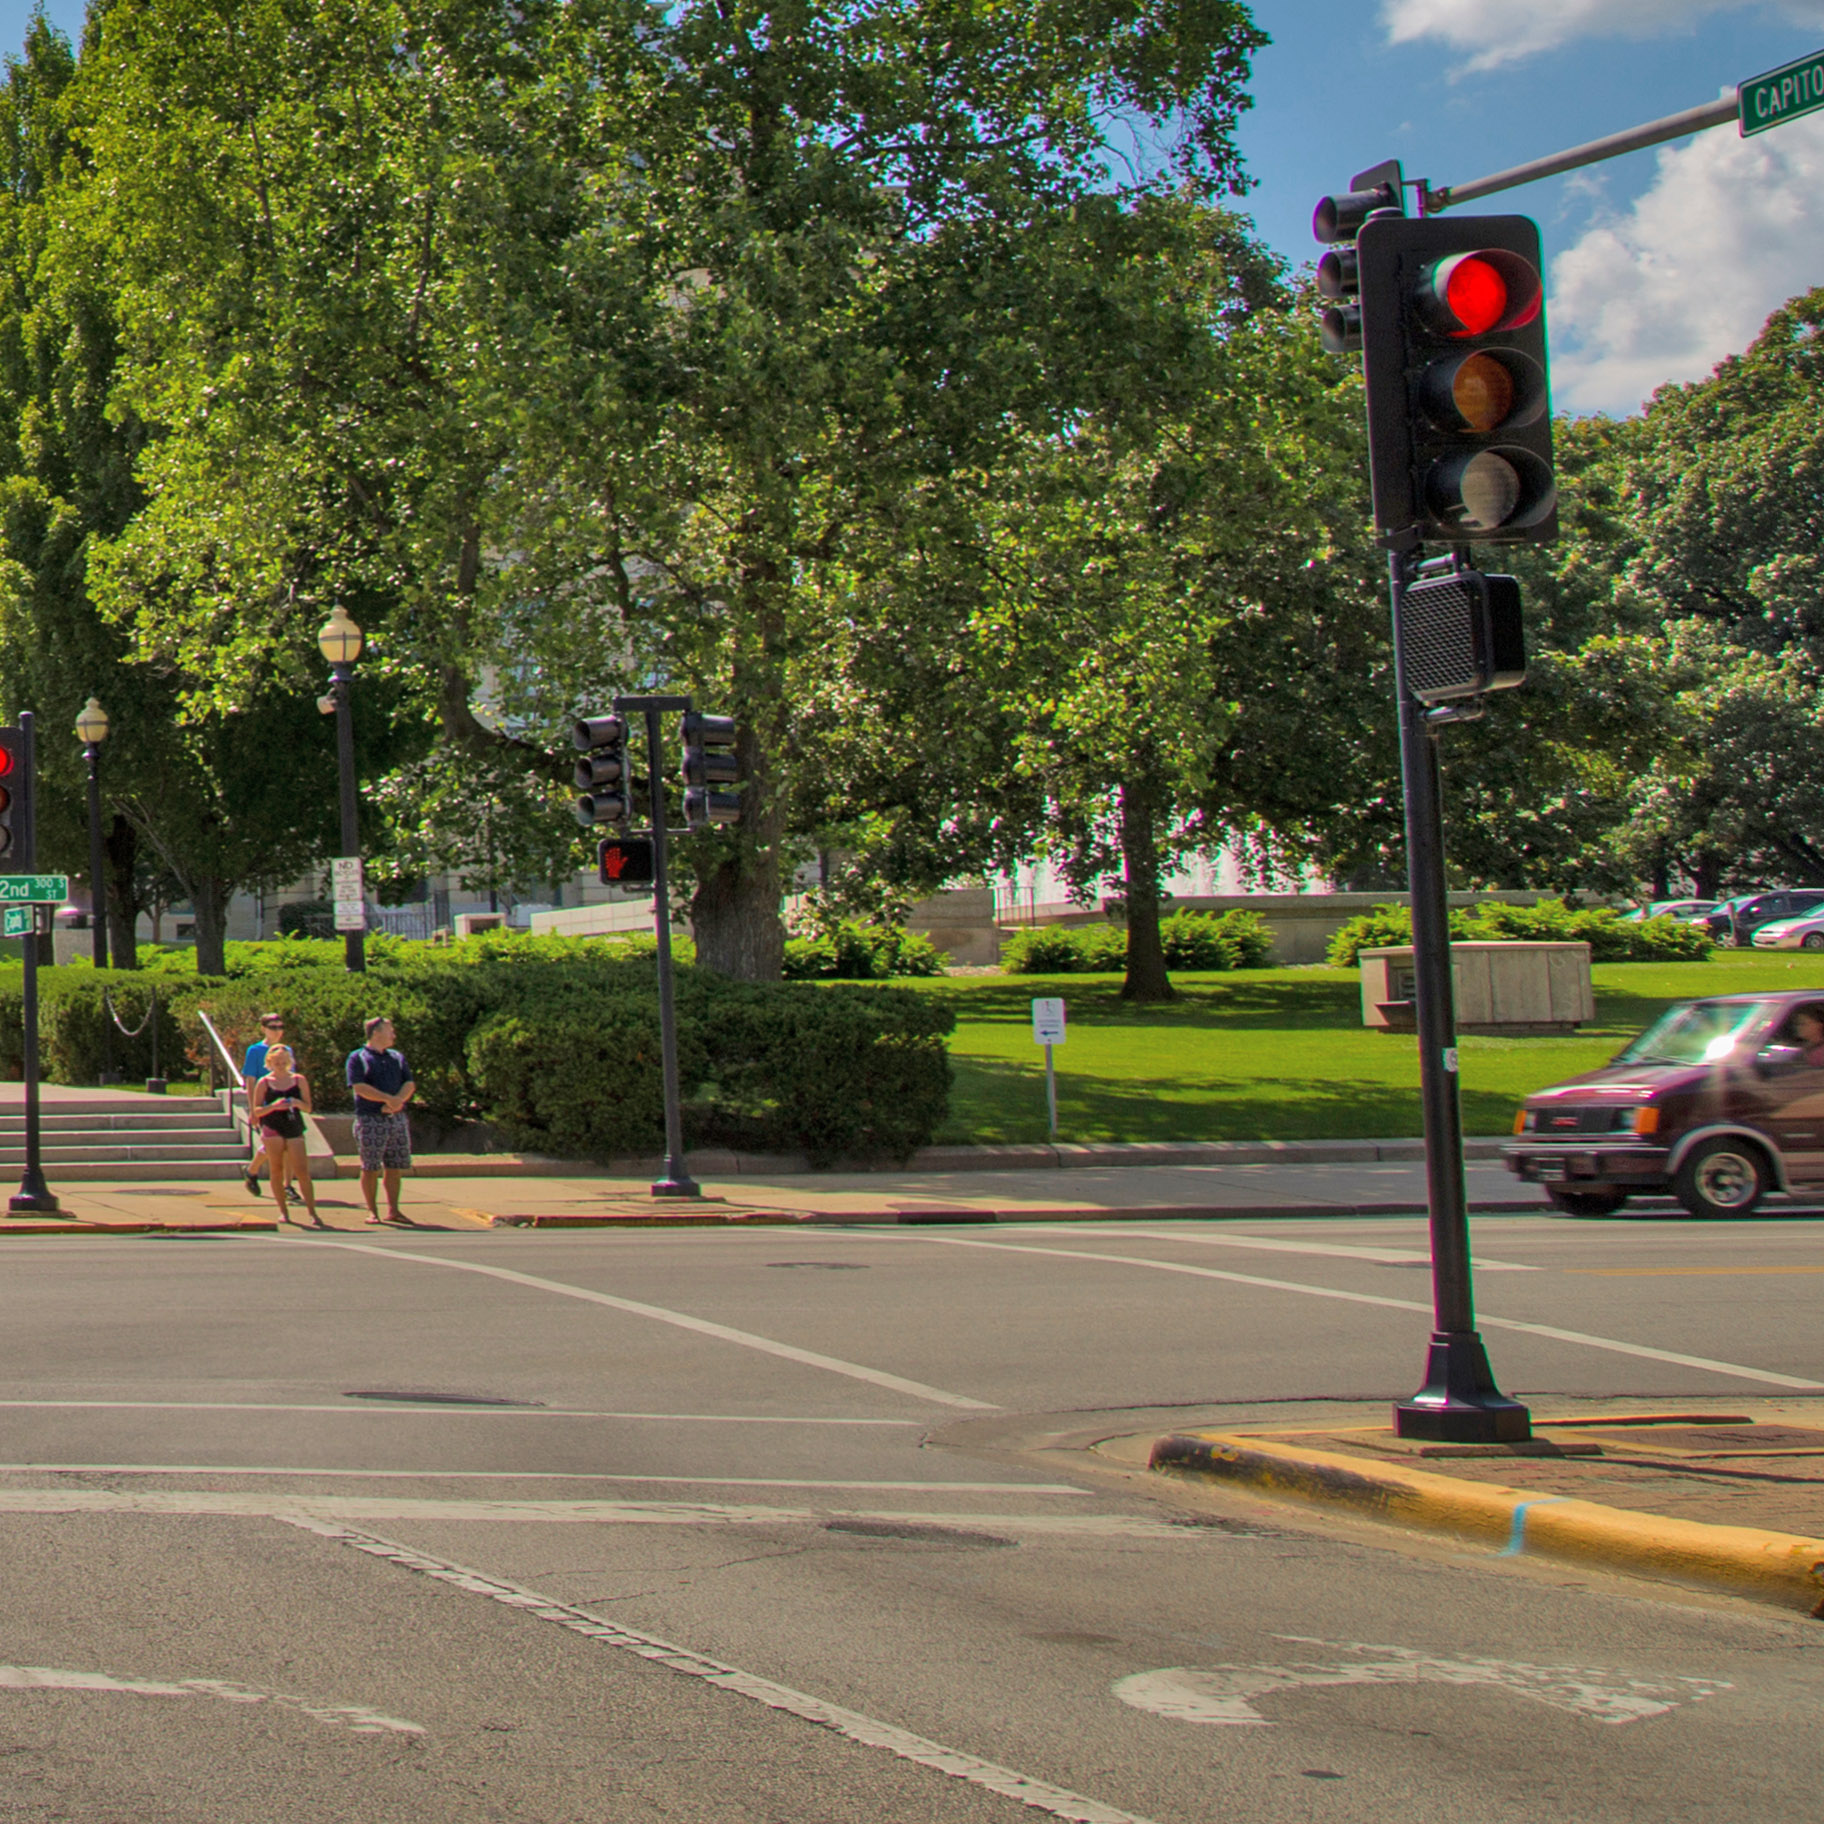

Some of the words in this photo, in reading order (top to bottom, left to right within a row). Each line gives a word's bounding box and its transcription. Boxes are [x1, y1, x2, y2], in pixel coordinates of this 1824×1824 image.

[1754, 64, 1824, 118] CAPITO
[338, 861, 353, 870] NO
[34, 878, 53, 888] 300
[58, 878, 64, 888] S
[46, 889, 56, 899] ST
